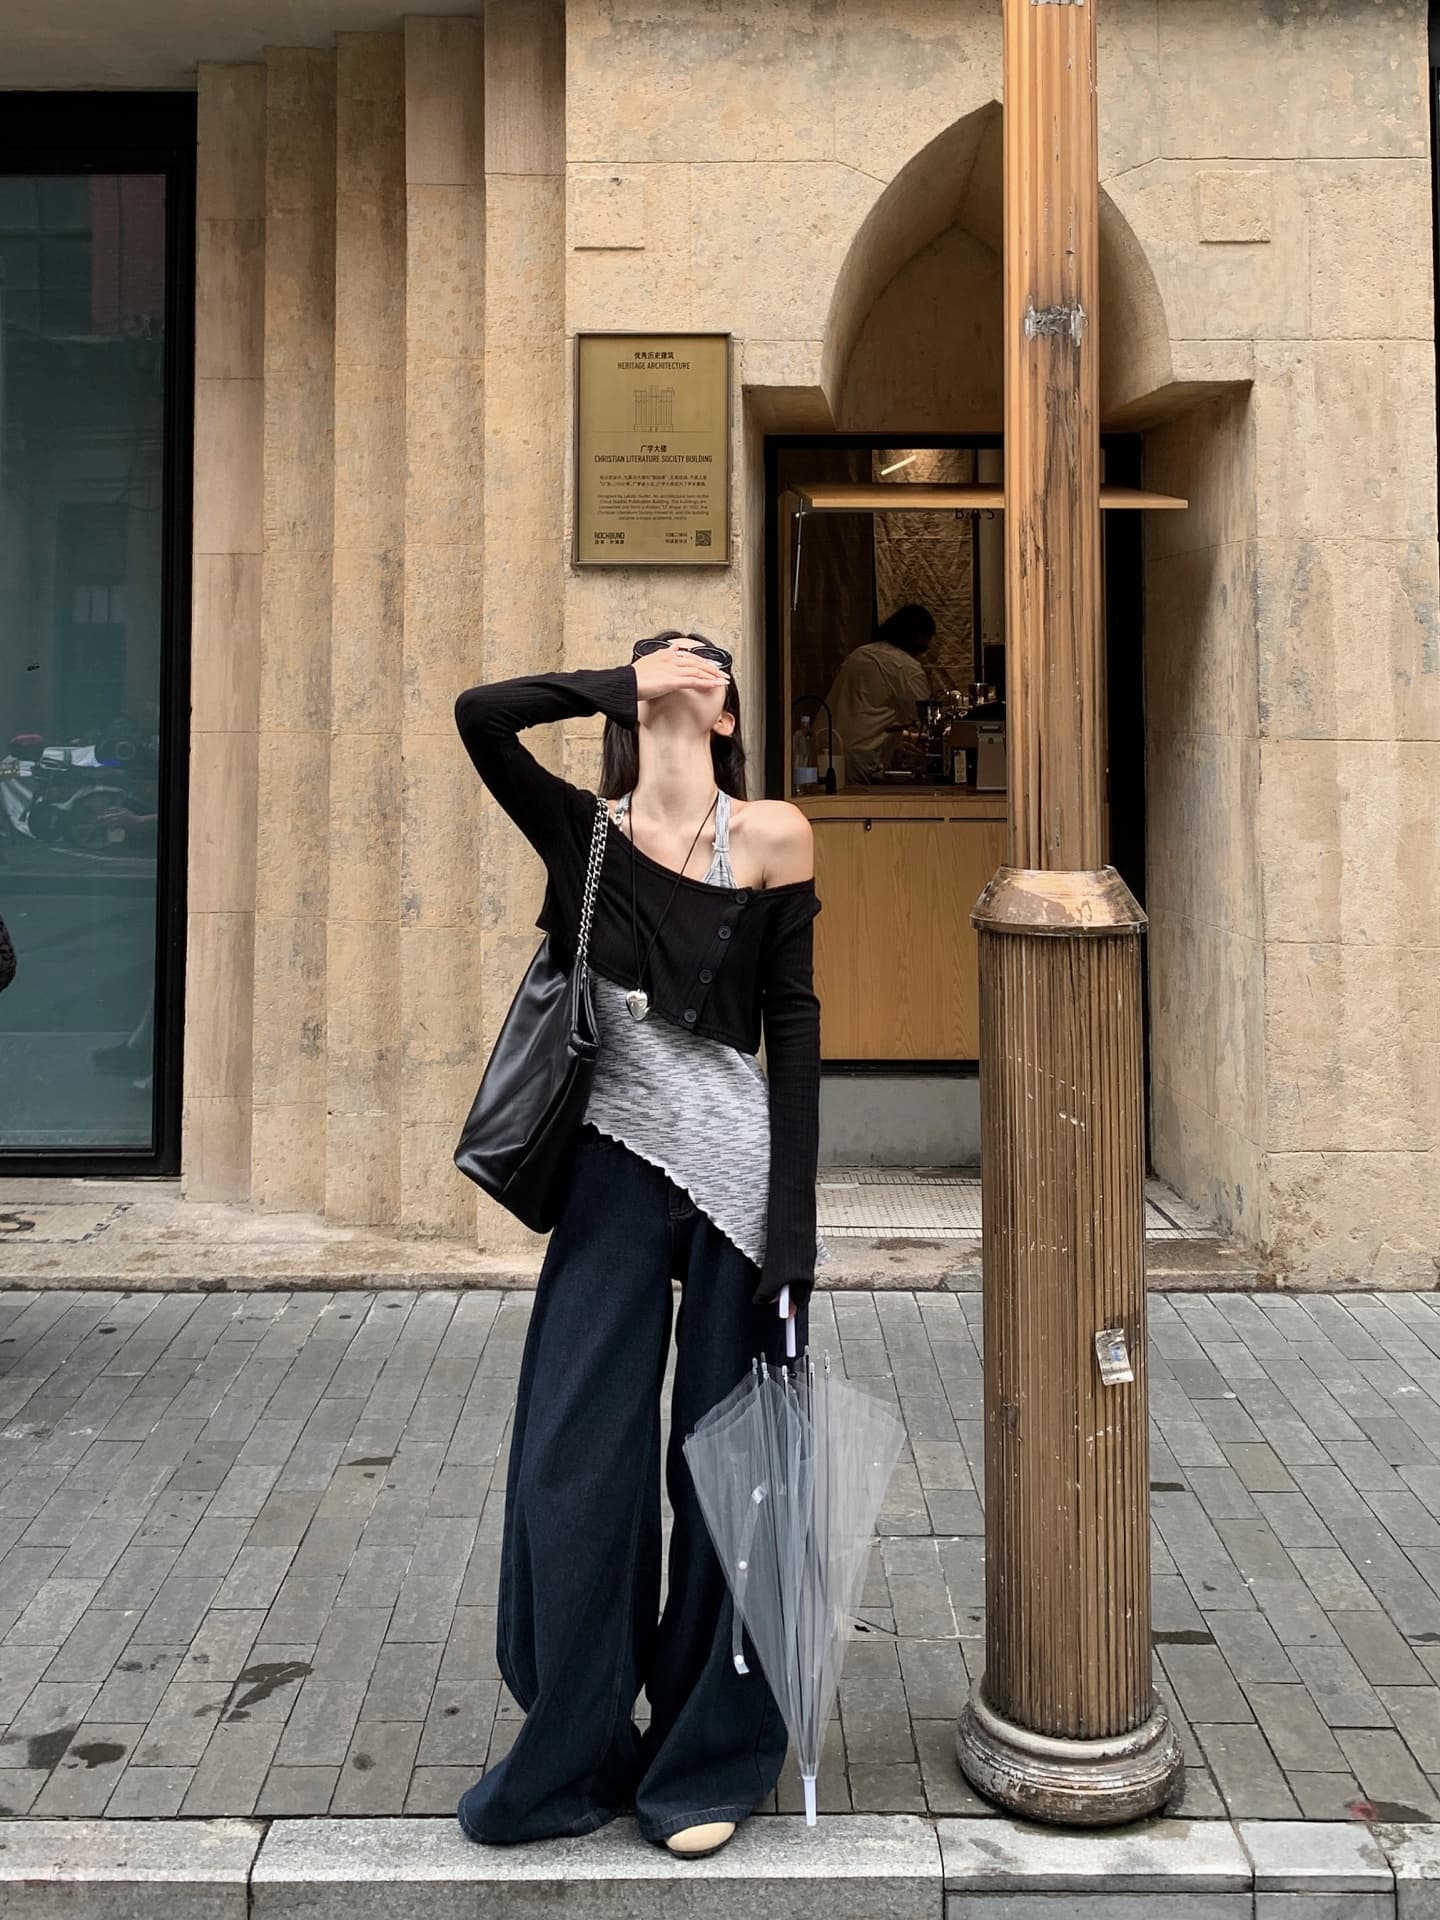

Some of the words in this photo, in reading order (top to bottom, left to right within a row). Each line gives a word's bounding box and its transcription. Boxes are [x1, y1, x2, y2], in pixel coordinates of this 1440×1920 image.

[617, 362, 645, 370] HERITAGE
[647, 362, 690, 370] ARCHITECTURE
[594, 455, 625, 463] CHRISTIAN
[626, 455, 660, 463] LITERATURE
[661, 455, 684, 463] SOCIETY
[685, 455, 712, 463] BUILDING
